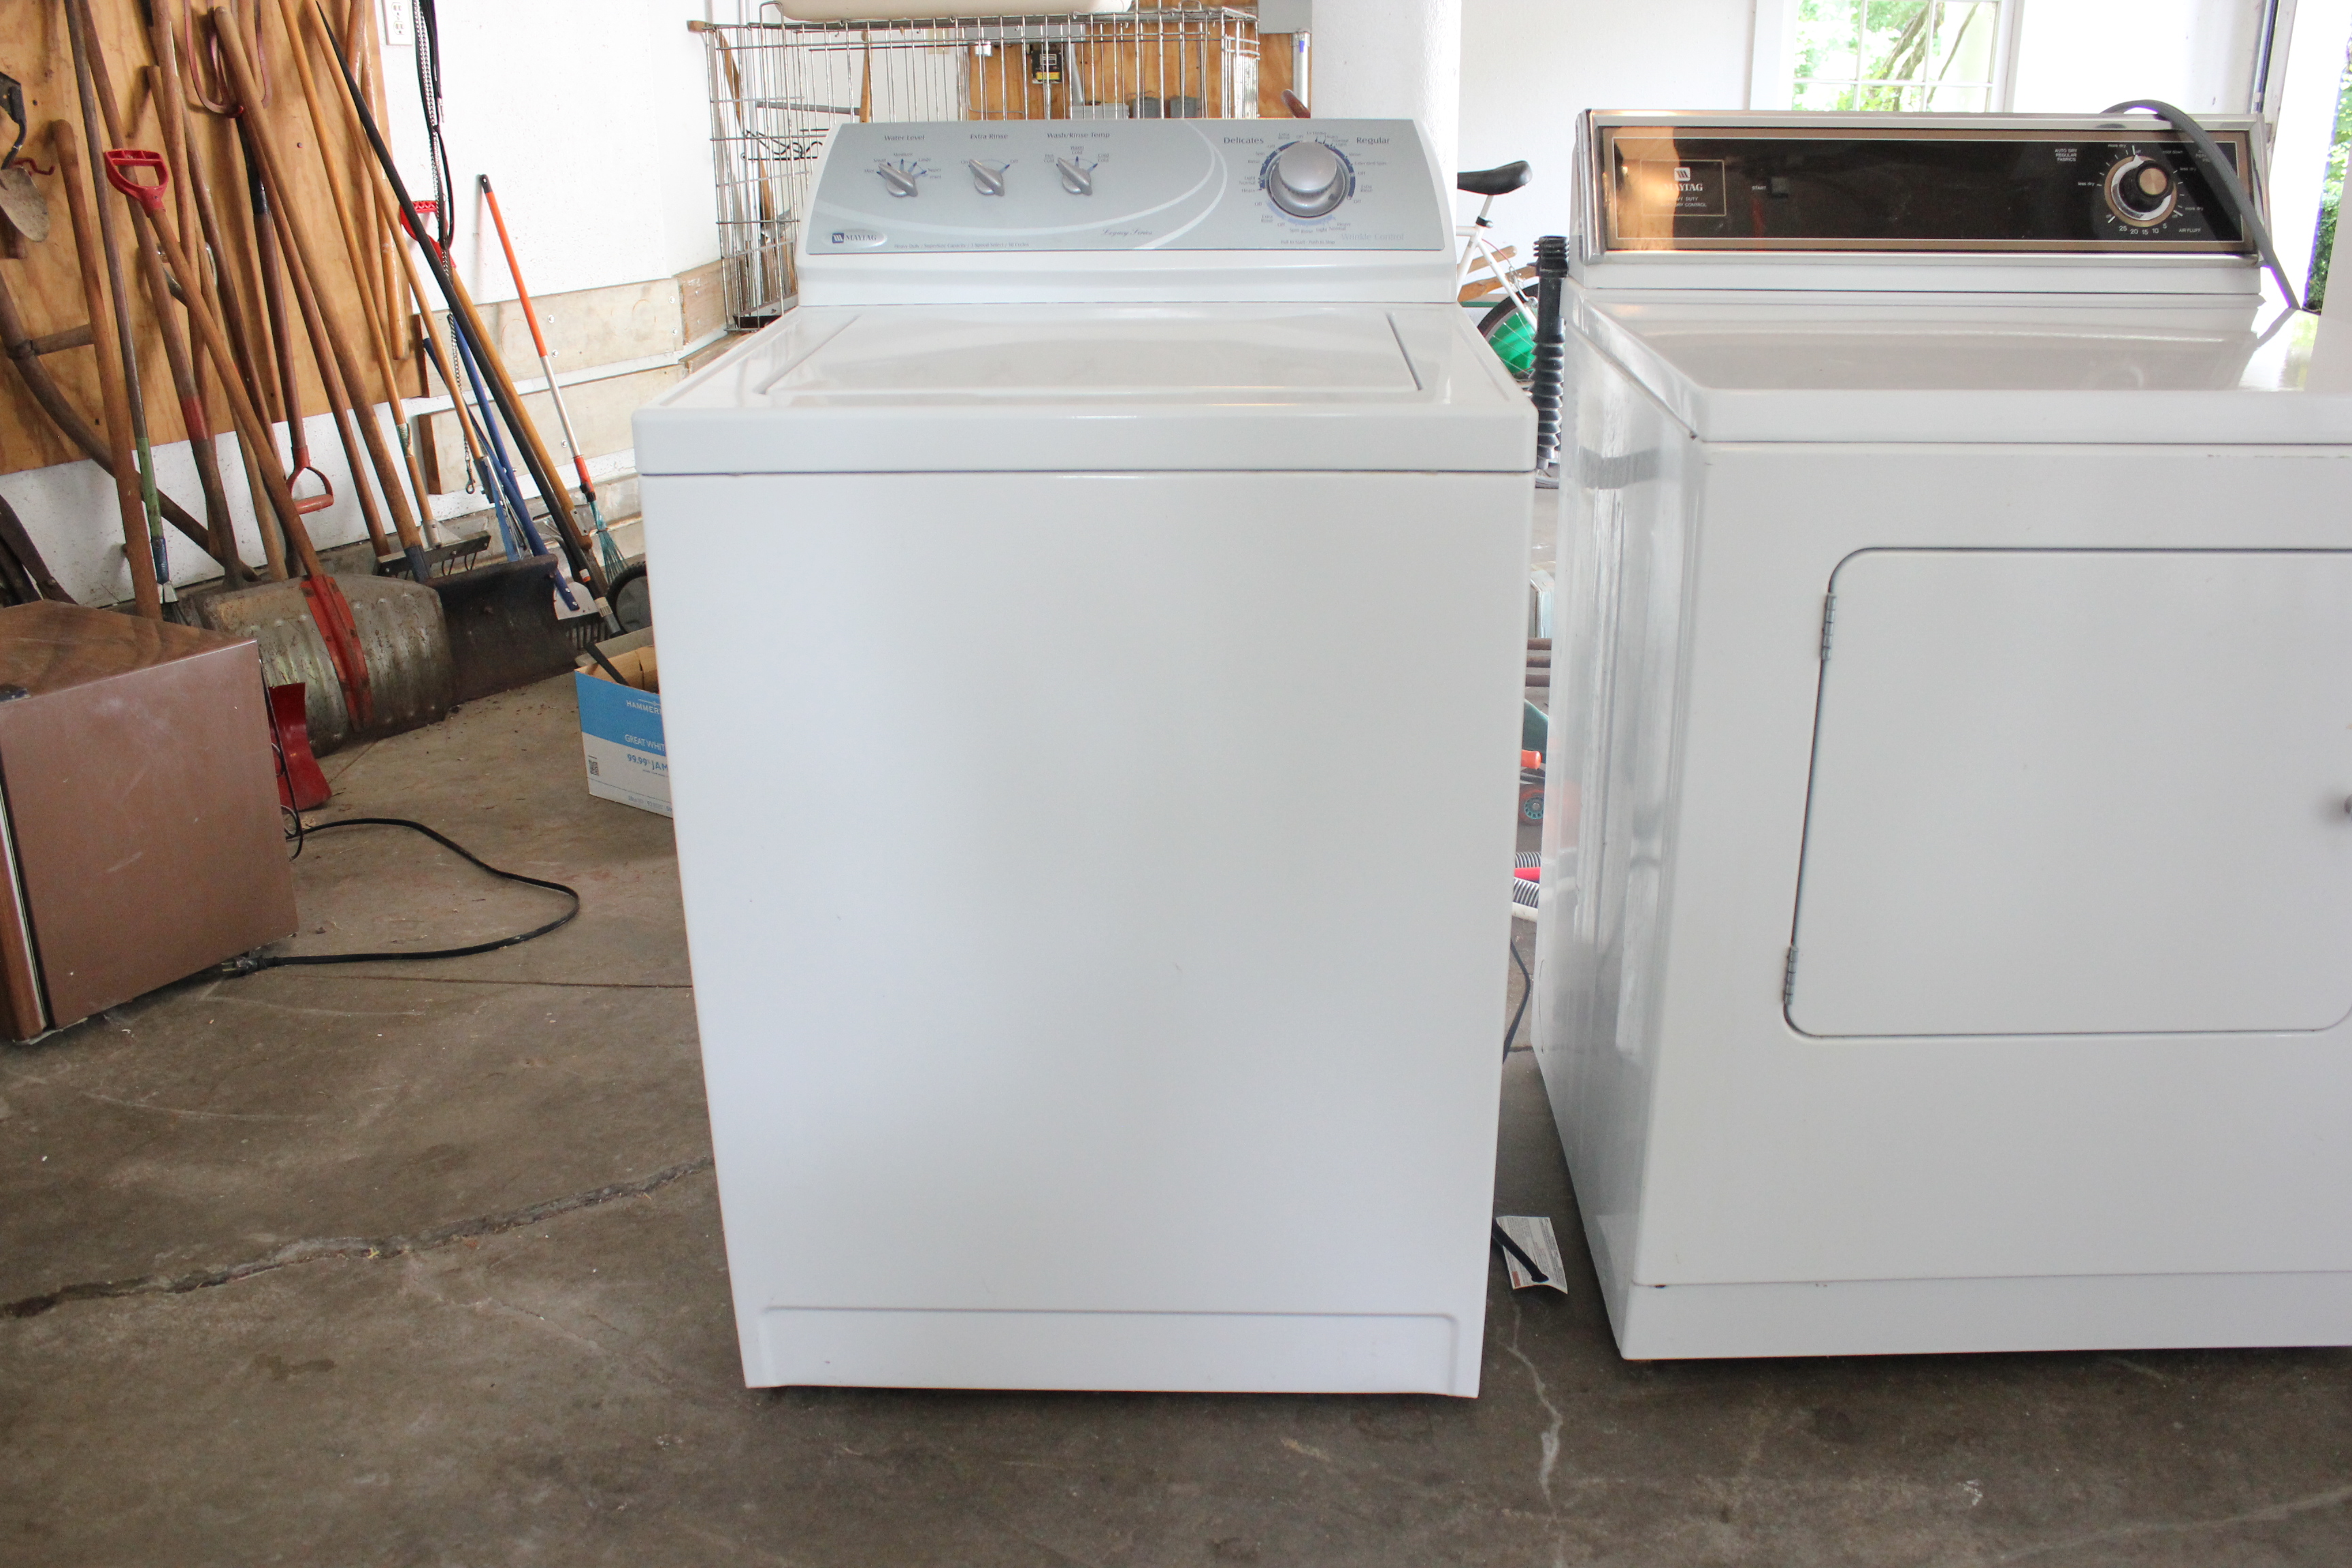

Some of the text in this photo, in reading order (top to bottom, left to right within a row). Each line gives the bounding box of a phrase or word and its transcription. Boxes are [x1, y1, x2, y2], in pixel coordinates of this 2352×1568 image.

[1223, 137, 1264, 145] Delicates
[1356, 137, 1390, 145] Regular
[1665, 183, 1703, 192] MAYTAG
[1341, 233, 1405, 241] Wrinkle Control
[625, 734, 665, 752] GREAT WHIT
[651, 760, 669, 771] JAM
